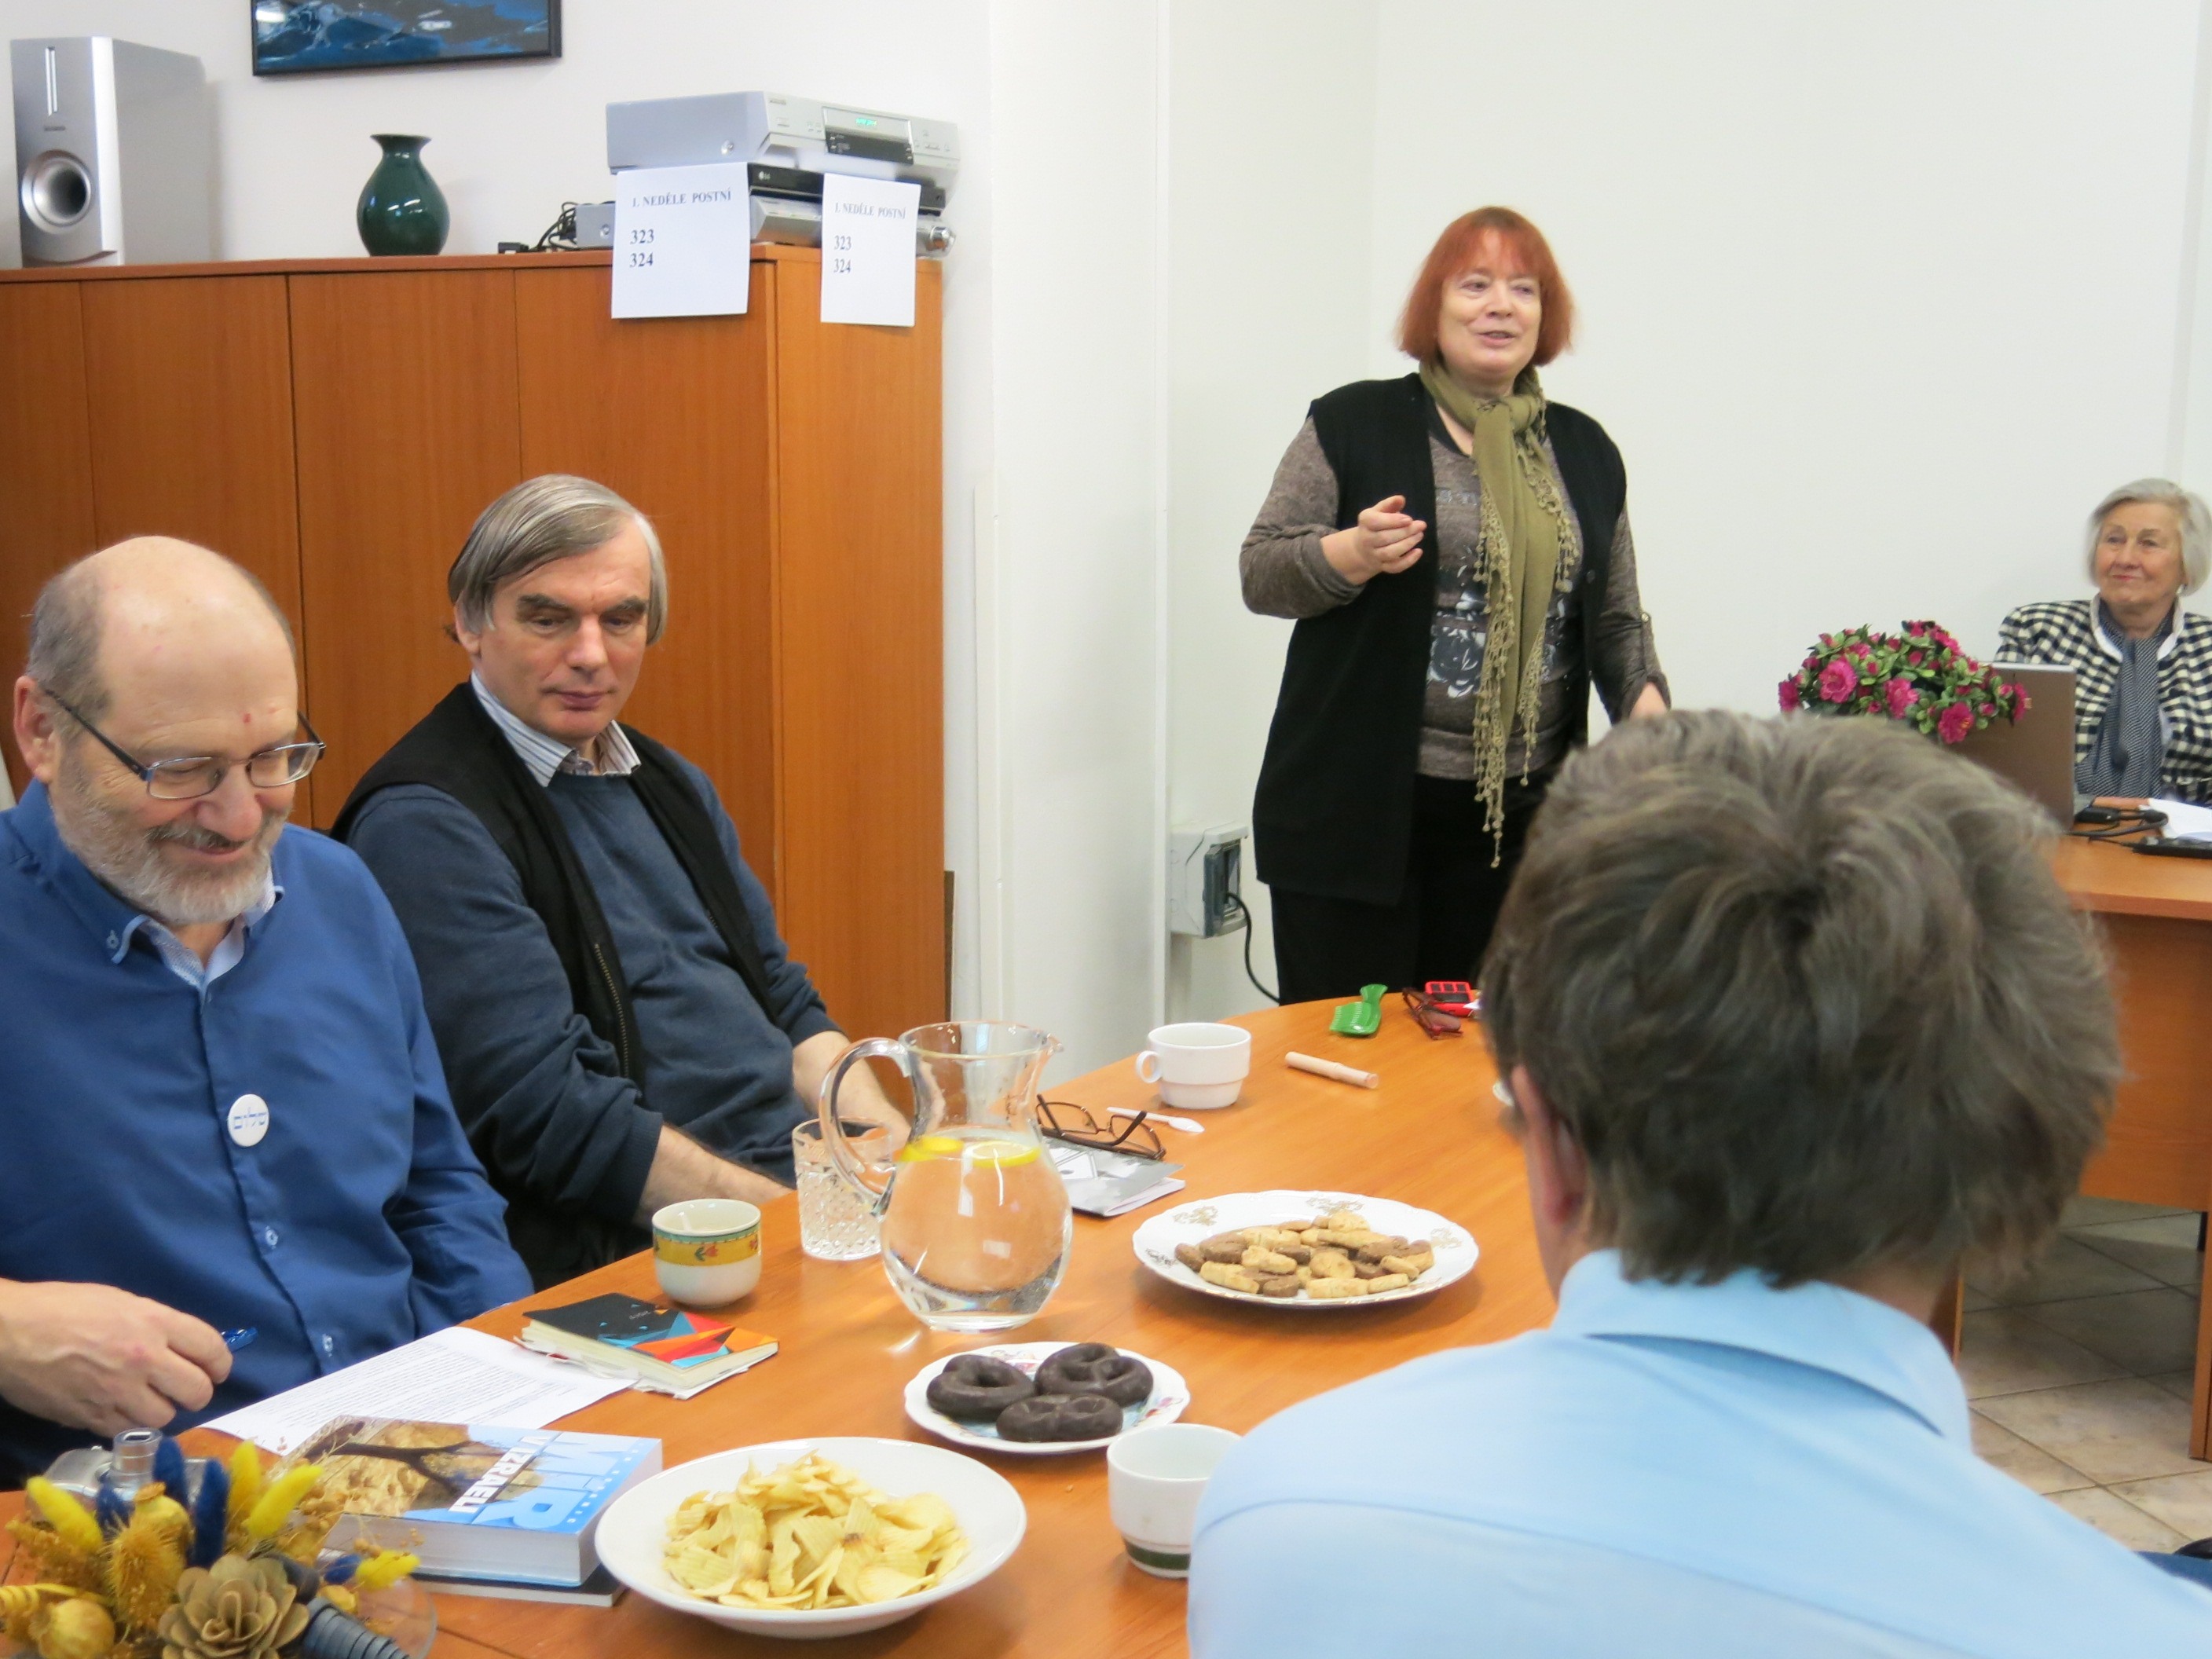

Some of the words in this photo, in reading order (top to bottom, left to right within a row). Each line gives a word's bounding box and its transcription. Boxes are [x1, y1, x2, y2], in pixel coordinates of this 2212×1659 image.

[629, 229, 654, 244] 323
[833, 235, 851, 251] 323
[629, 251, 654, 268] 324
[833, 258, 851, 273] 324
[449, 1445, 539, 1514] IZRAELI
